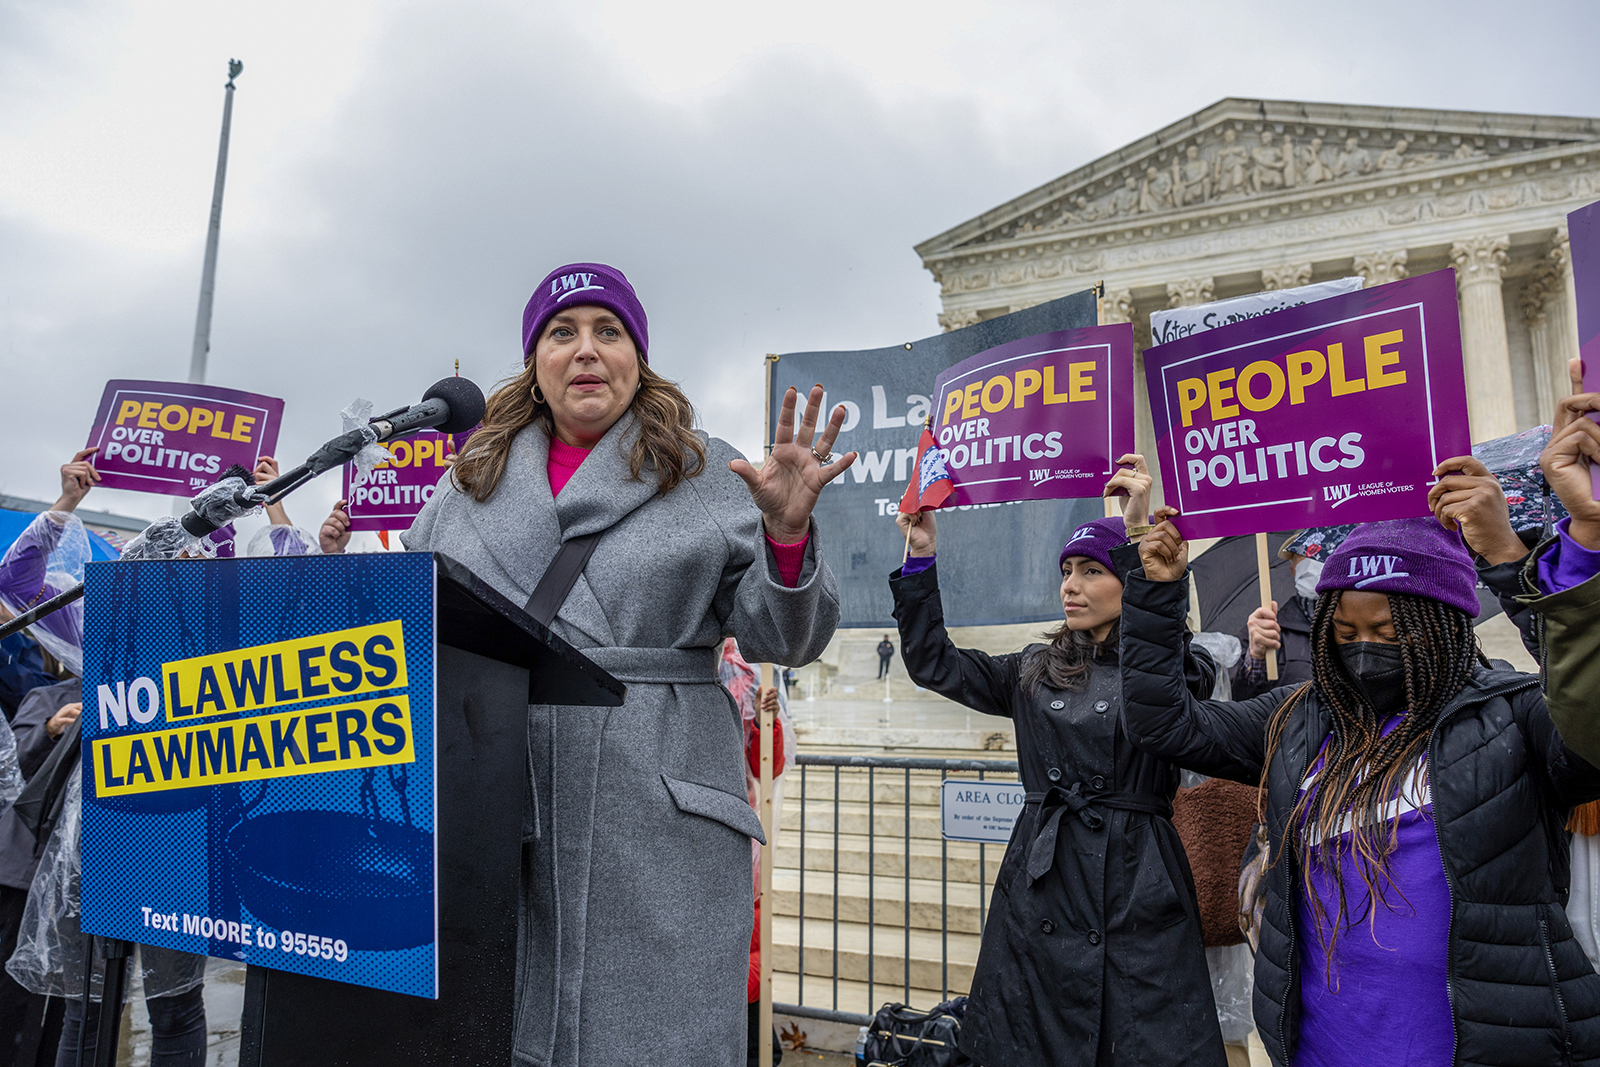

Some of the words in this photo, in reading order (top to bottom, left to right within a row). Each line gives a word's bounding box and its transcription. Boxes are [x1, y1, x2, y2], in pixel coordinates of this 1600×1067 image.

[550, 273, 593, 296] LWV
[1152, 319, 1197, 345] Voter
[1176, 329, 1407, 428] PEOPLE
[872, 385, 933, 430] La
[941, 361, 1096, 426] PEOPLE
[115, 400, 256, 443] PEOPLE
[940, 418, 990, 446] OVER
[112, 427, 165, 446] OVER
[939, 431, 1063, 470] POLITICS
[1184, 419, 1260, 455] OVER
[104, 442, 222, 474] POLITICS
[374, 440, 446, 468] EOPL
[1187, 432, 1365, 492] POLITICS
[1029, 469, 1051, 481] LWV
[1358, 481, 1384, 491] LEAGUE
[356, 484, 436, 505] POLITIC
[1323, 484, 1351, 501] LWV
[1359, 487, 1386, 497] WOMEN
[1386, 484, 1414, 494] VOTERS
[1347, 555, 1398, 577] LWV
[98, 676, 160, 730] NO
[169, 634, 398, 718] LAWLESS
[101, 703, 407, 789] LAWMAKERS
[955, 790, 991, 804] AREA
[996, 792, 1026, 805] CLO
[141, 906, 179, 932] Text
[183, 913, 252, 945] MOORE
[256, 926, 276, 949] to
[281, 930, 348, 963] 95559
